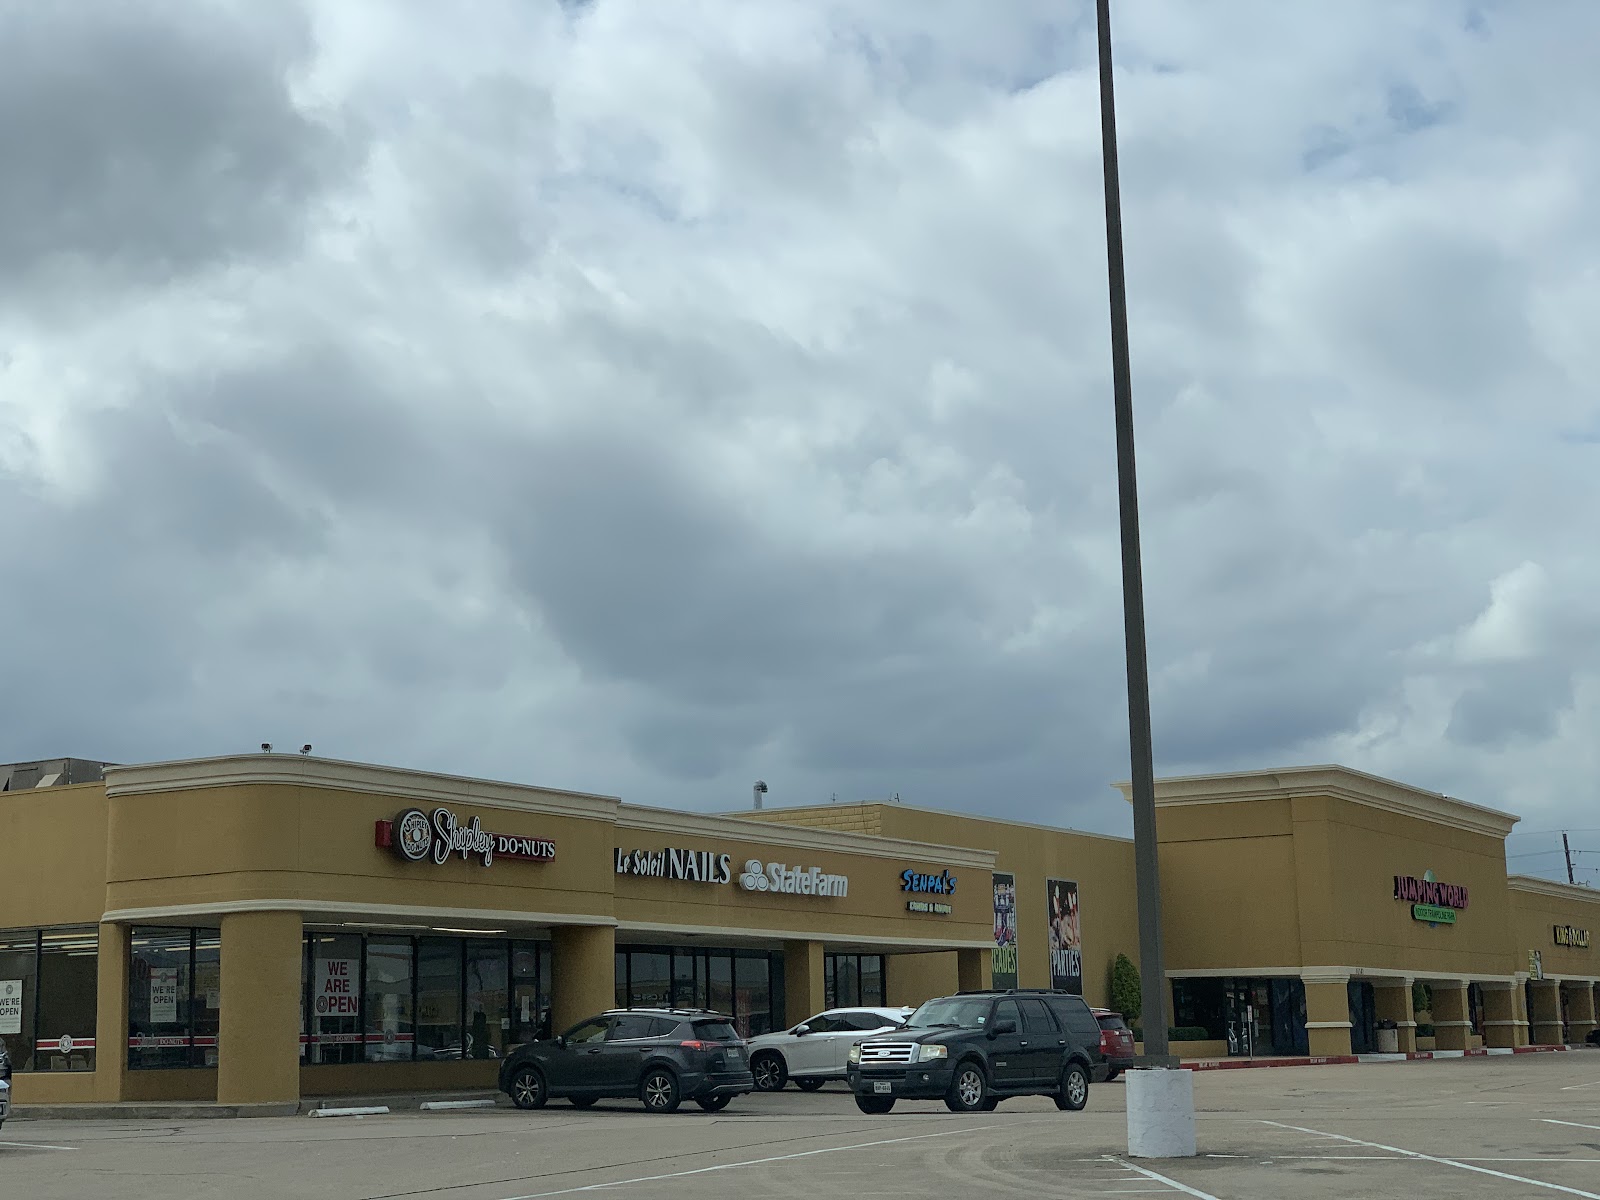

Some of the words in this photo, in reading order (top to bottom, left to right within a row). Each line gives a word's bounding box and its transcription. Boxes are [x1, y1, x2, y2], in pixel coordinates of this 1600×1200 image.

[404, 818, 429, 833] SHIPLEY
[433, 807, 496, 868] Shipley
[498, 836, 556, 858] DO-NUTS
[616, 848, 631, 874] Le
[632, 849, 666, 878] Soleil
[668, 848, 731, 885] NAILS
[1397, 875, 1439, 904] JUMPING
[1440, 883, 1469, 909] WORLD
[328, 961, 348, 976] WE
[992, 948, 1016, 974] CADES
[1053, 950, 1081, 977] PARTIES
[324, 978, 351, 993] ARE
[153, 996, 174, 1004] OPEN
[0, 1007, 19, 1016] OPEN
